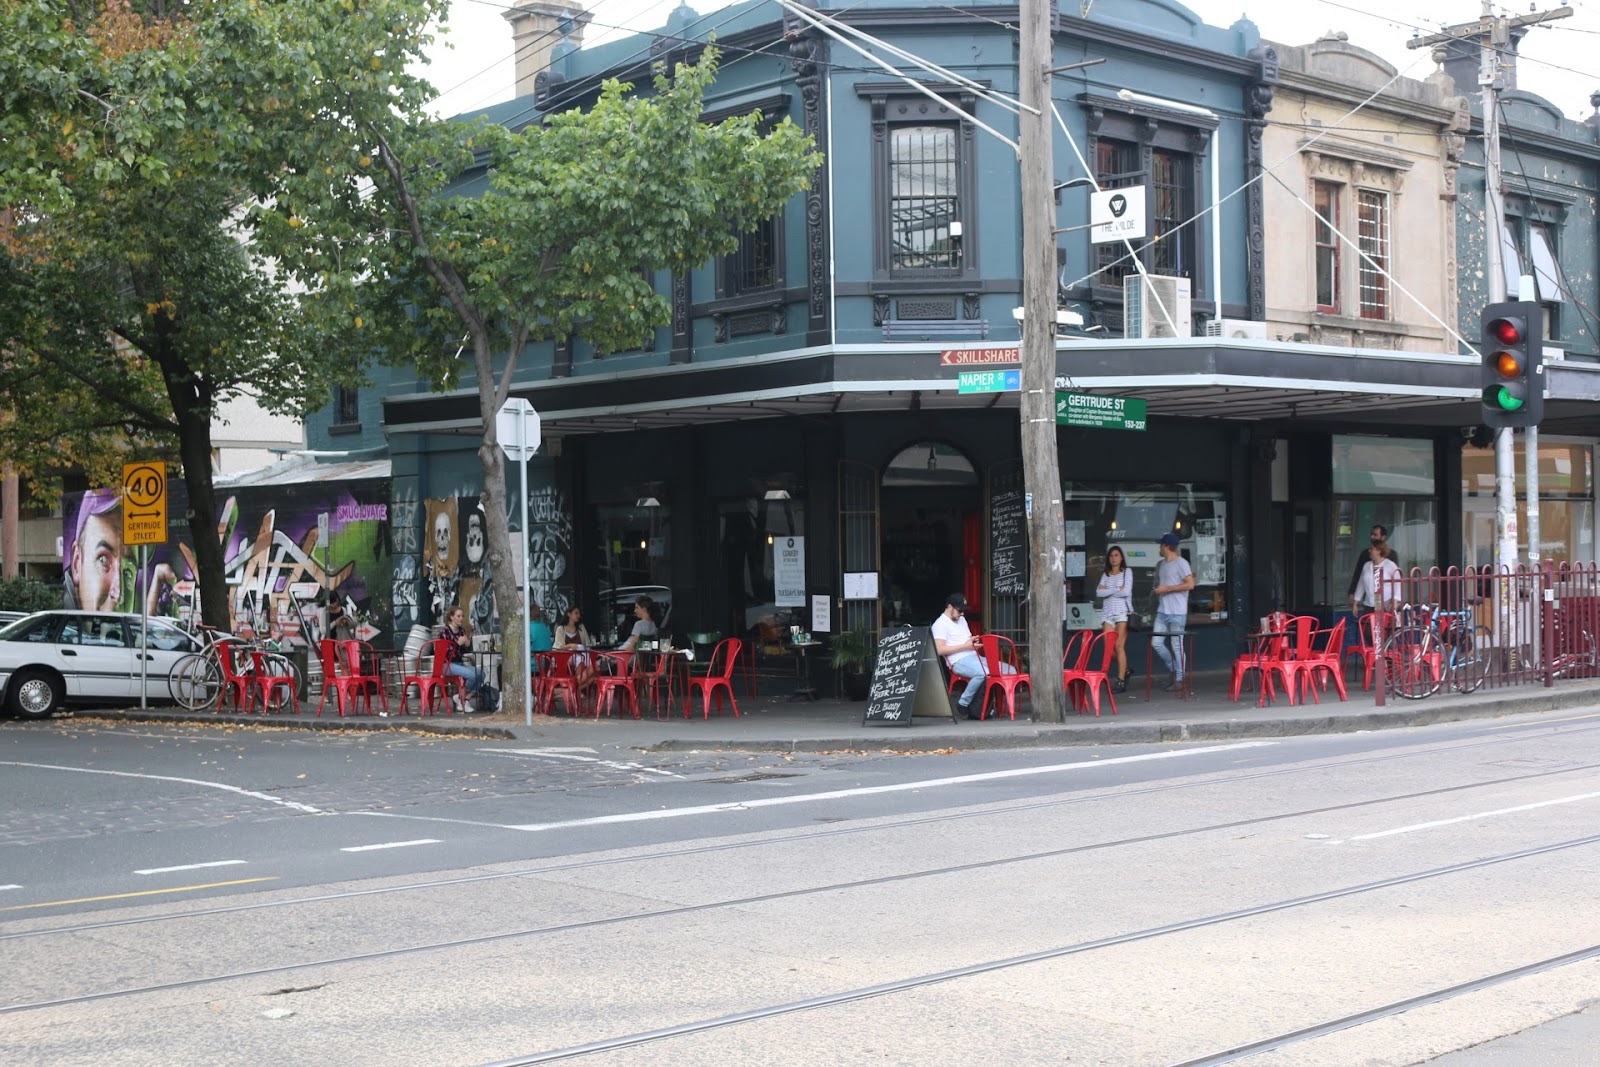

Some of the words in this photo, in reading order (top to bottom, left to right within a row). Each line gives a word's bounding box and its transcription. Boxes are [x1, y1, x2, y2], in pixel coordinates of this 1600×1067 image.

[956, 349, 1018, 363] SKILLSHARE
[961, 373, 994, 386] NAPIER
[997, 372, 1005, 380] ST
[1068, 394, 1113, 409] GERTRUDE
[1114, 398, 1125, 410] ST
[130, 476, 158, 496] 40
[128, 521, 161, 530] GERTRUDE
[133, 532, 156, 540] STREET
[878, 630, 913, 647] SPECIALS
[866, 702, 882, 718] $12
